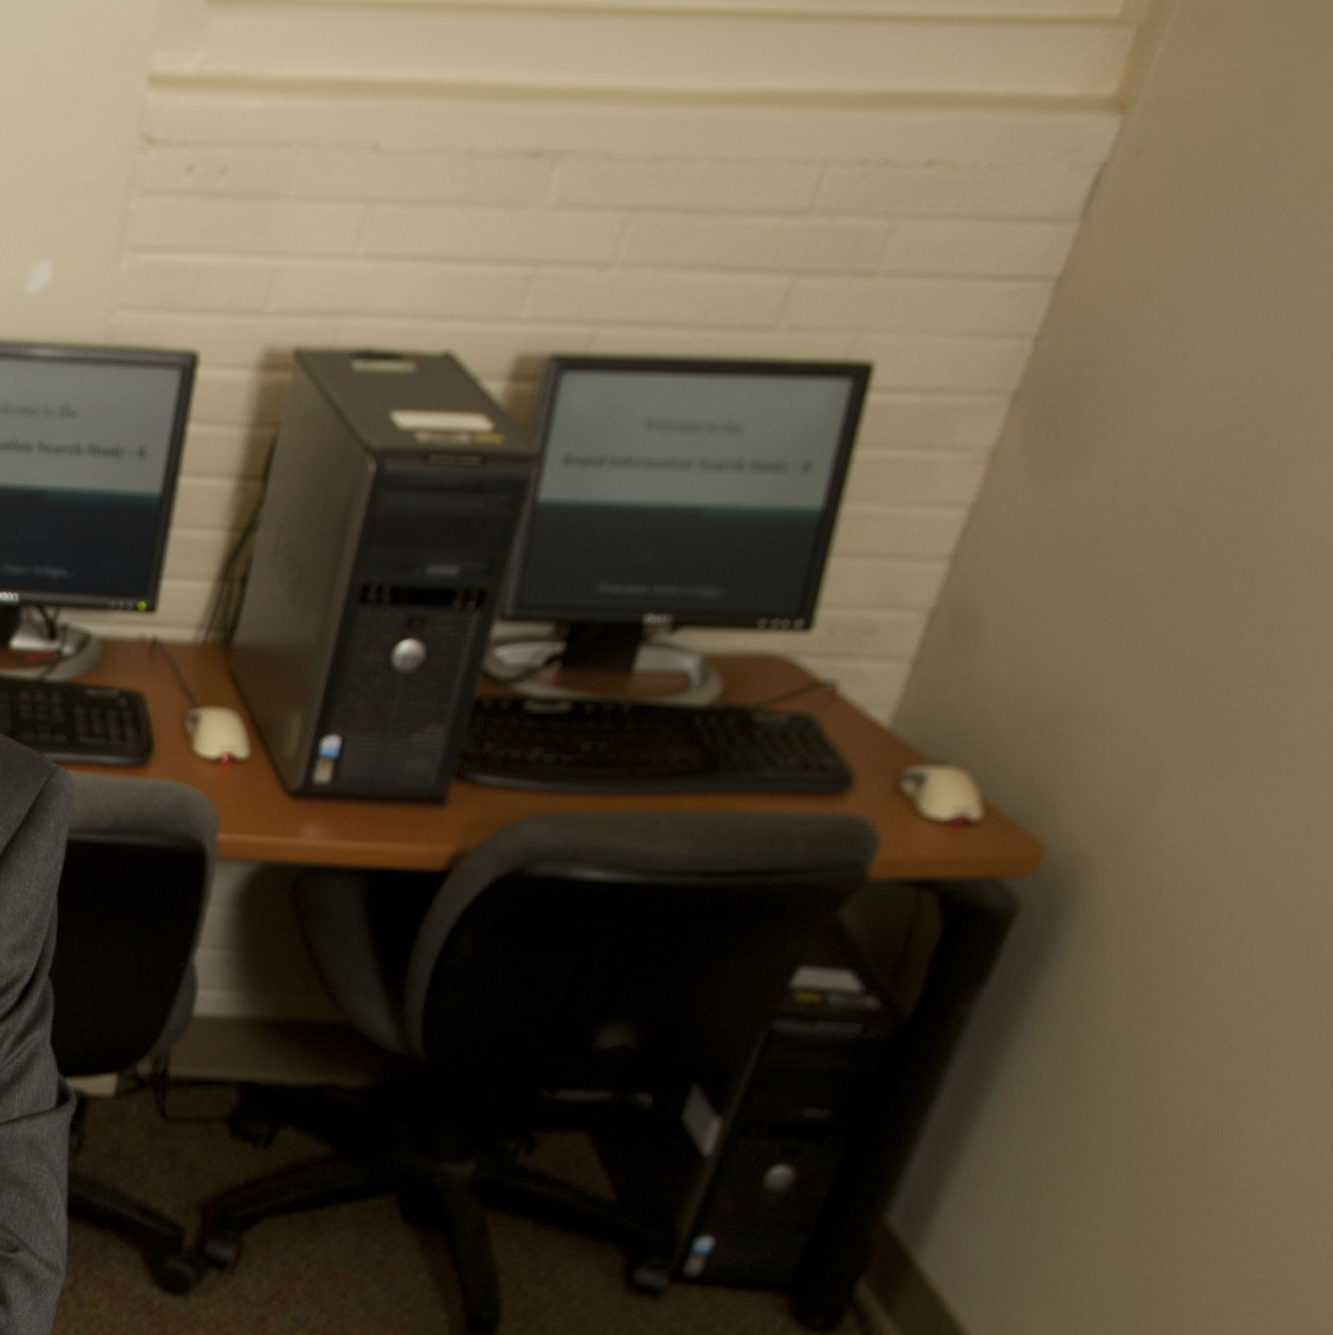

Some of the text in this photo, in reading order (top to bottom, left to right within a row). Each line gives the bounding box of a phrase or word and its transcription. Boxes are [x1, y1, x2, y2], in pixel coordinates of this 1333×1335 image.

[37, 440, 81, 455] Search
[87, 443, 123, 459] Study
[609, 455, 693, 471] Information
